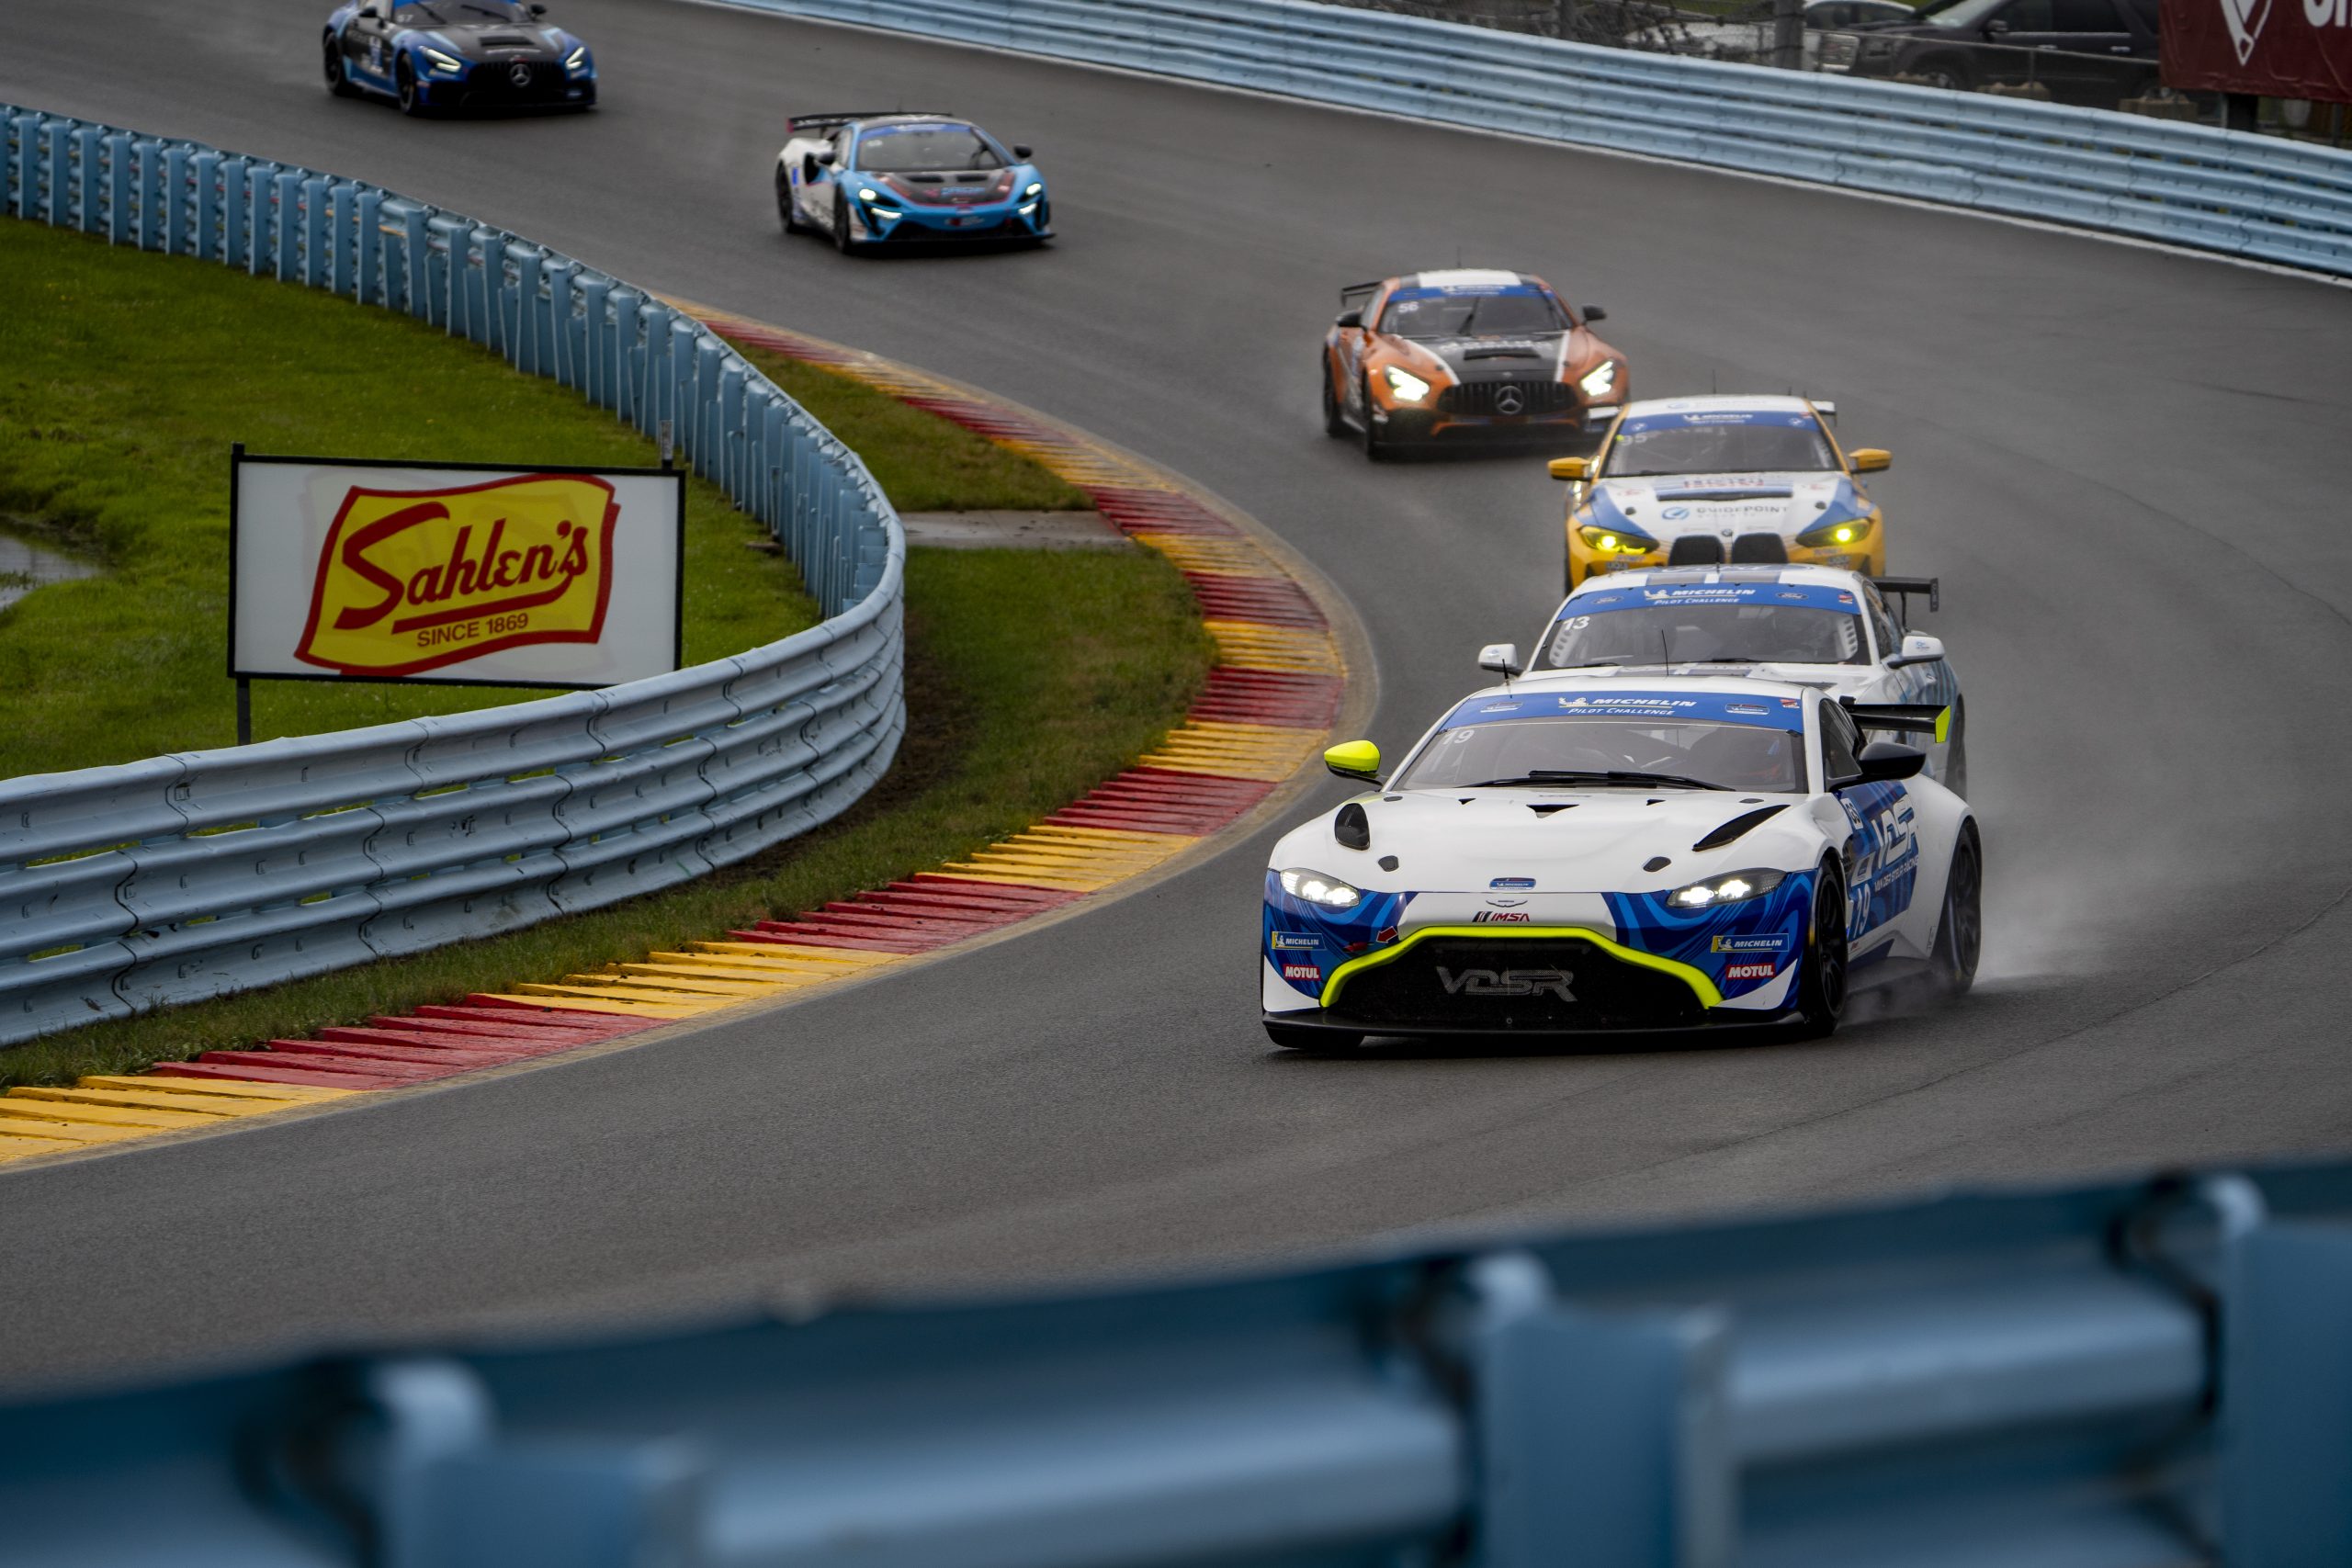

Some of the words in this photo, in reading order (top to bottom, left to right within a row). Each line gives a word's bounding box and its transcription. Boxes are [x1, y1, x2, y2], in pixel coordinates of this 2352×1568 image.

[1397, 301, 1419, 314] 56
[333, 501, 589, 630] Sahlen's
[1671, 588, 1756, 596] MICHELIN
[1563, 615, 1590, 631] 13
[416, 621, 480, 648] SINCE
[485, 613, 529, 637] 1869
[1591, 697, 1698, 708] MICHELIN
[1568, 706, 1604, 716] PILOT
[1607, 706, 1675, 716] CHALLENGE
[1442, 728, 1476, 746] 19
[1490, 912, 1531, 922] IMSA
[1853, 883, 1871, 939] 19
[1734, 939, 1783, 948] MICHELIN
[1284, 965, 1319, 979] MOTUL
[1727, 964, 1774, 978] MOTUL
[1436, 965, 1578, 1002] VDSR
